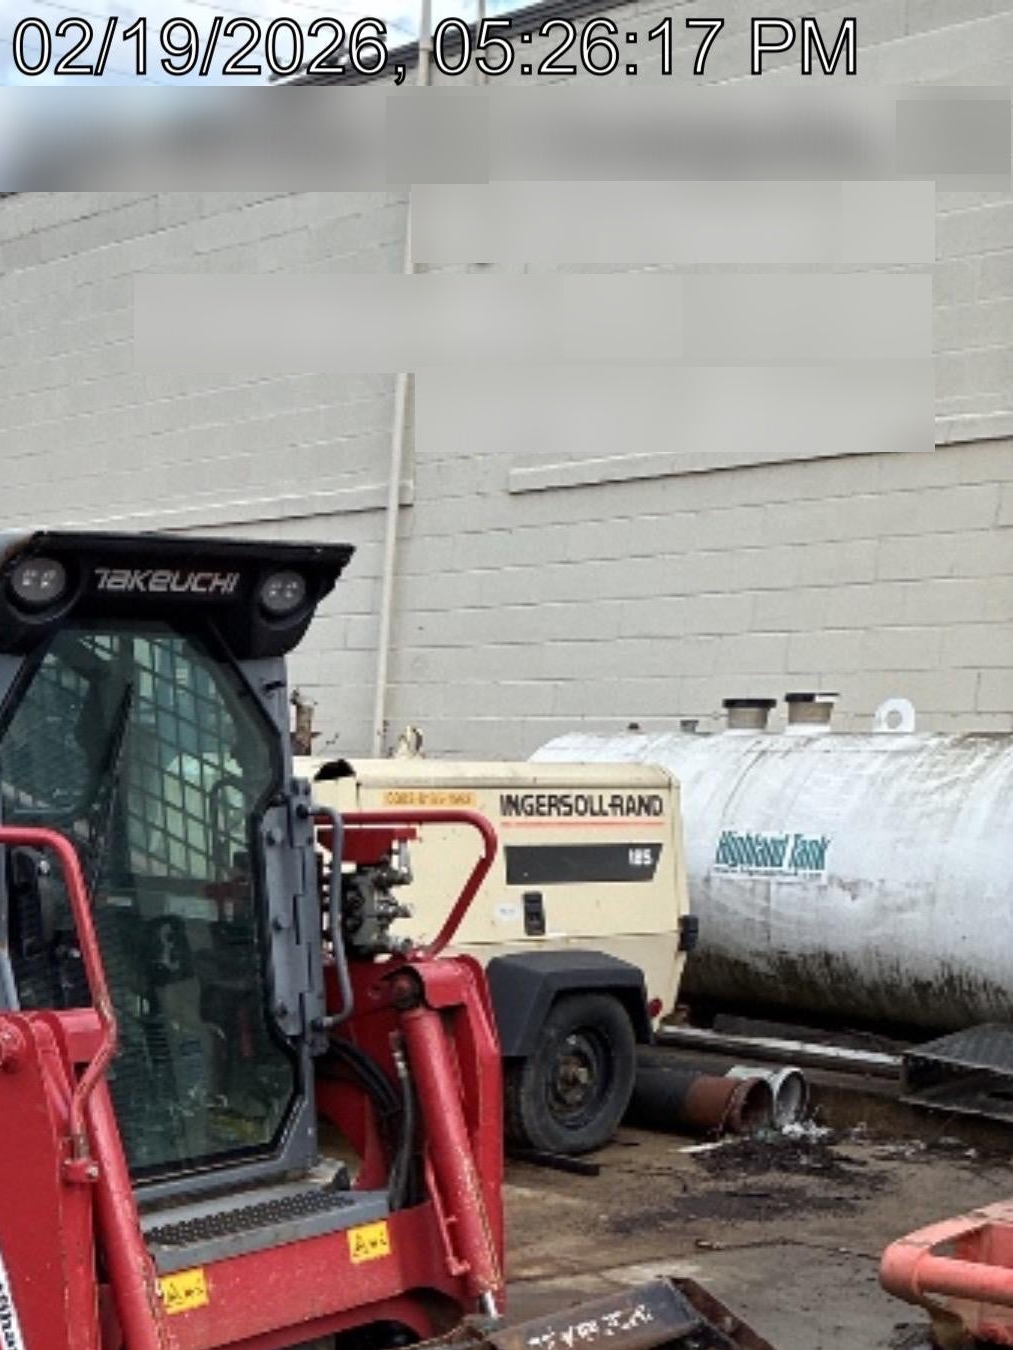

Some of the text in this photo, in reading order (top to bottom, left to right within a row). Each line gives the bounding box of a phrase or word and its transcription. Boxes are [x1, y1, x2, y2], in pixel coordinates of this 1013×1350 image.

[94, 568, 240, 595] TAKEUCHI
[715, 830, 831, 870] Highland Tank
